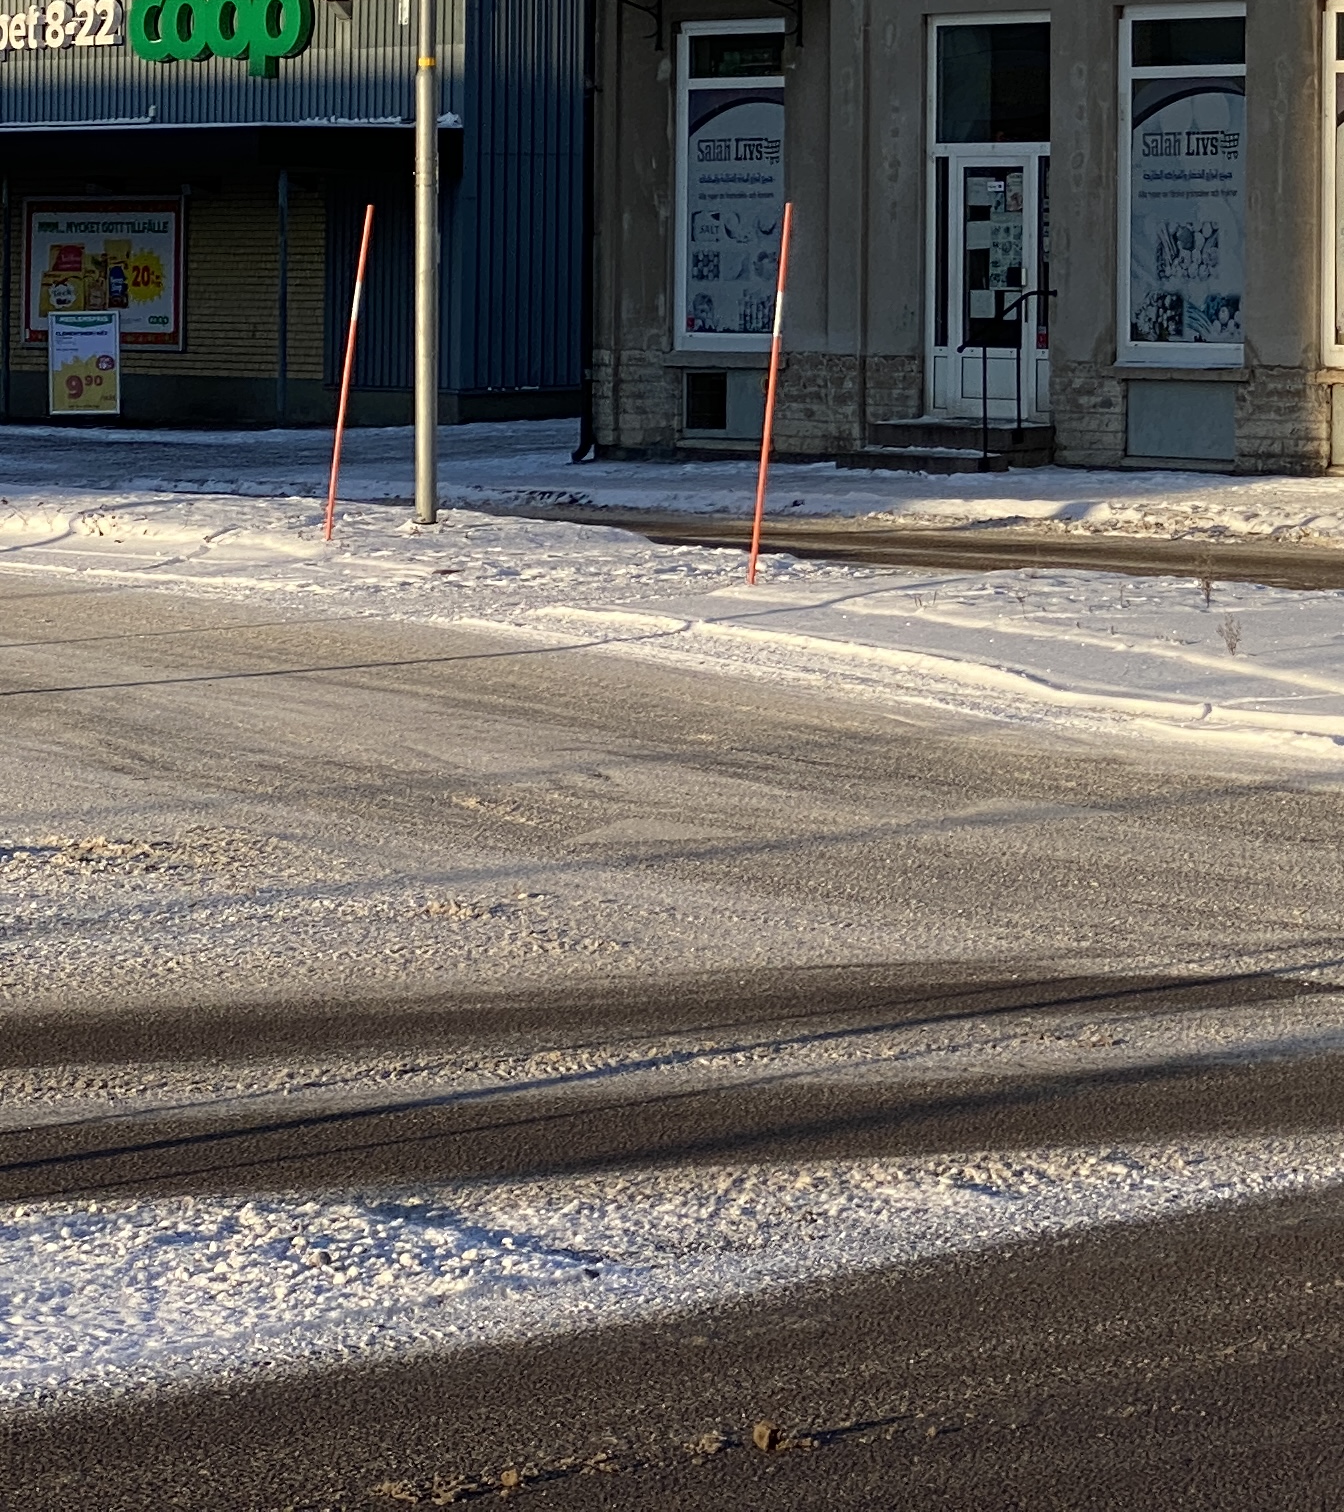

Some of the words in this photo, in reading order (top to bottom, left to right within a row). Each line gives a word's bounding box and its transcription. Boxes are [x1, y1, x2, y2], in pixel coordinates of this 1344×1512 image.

[697, 138, 732, 162] Salah
[1142, 132, 1182, 158] Salah
[1184, 130, 1220, 157] Livs
